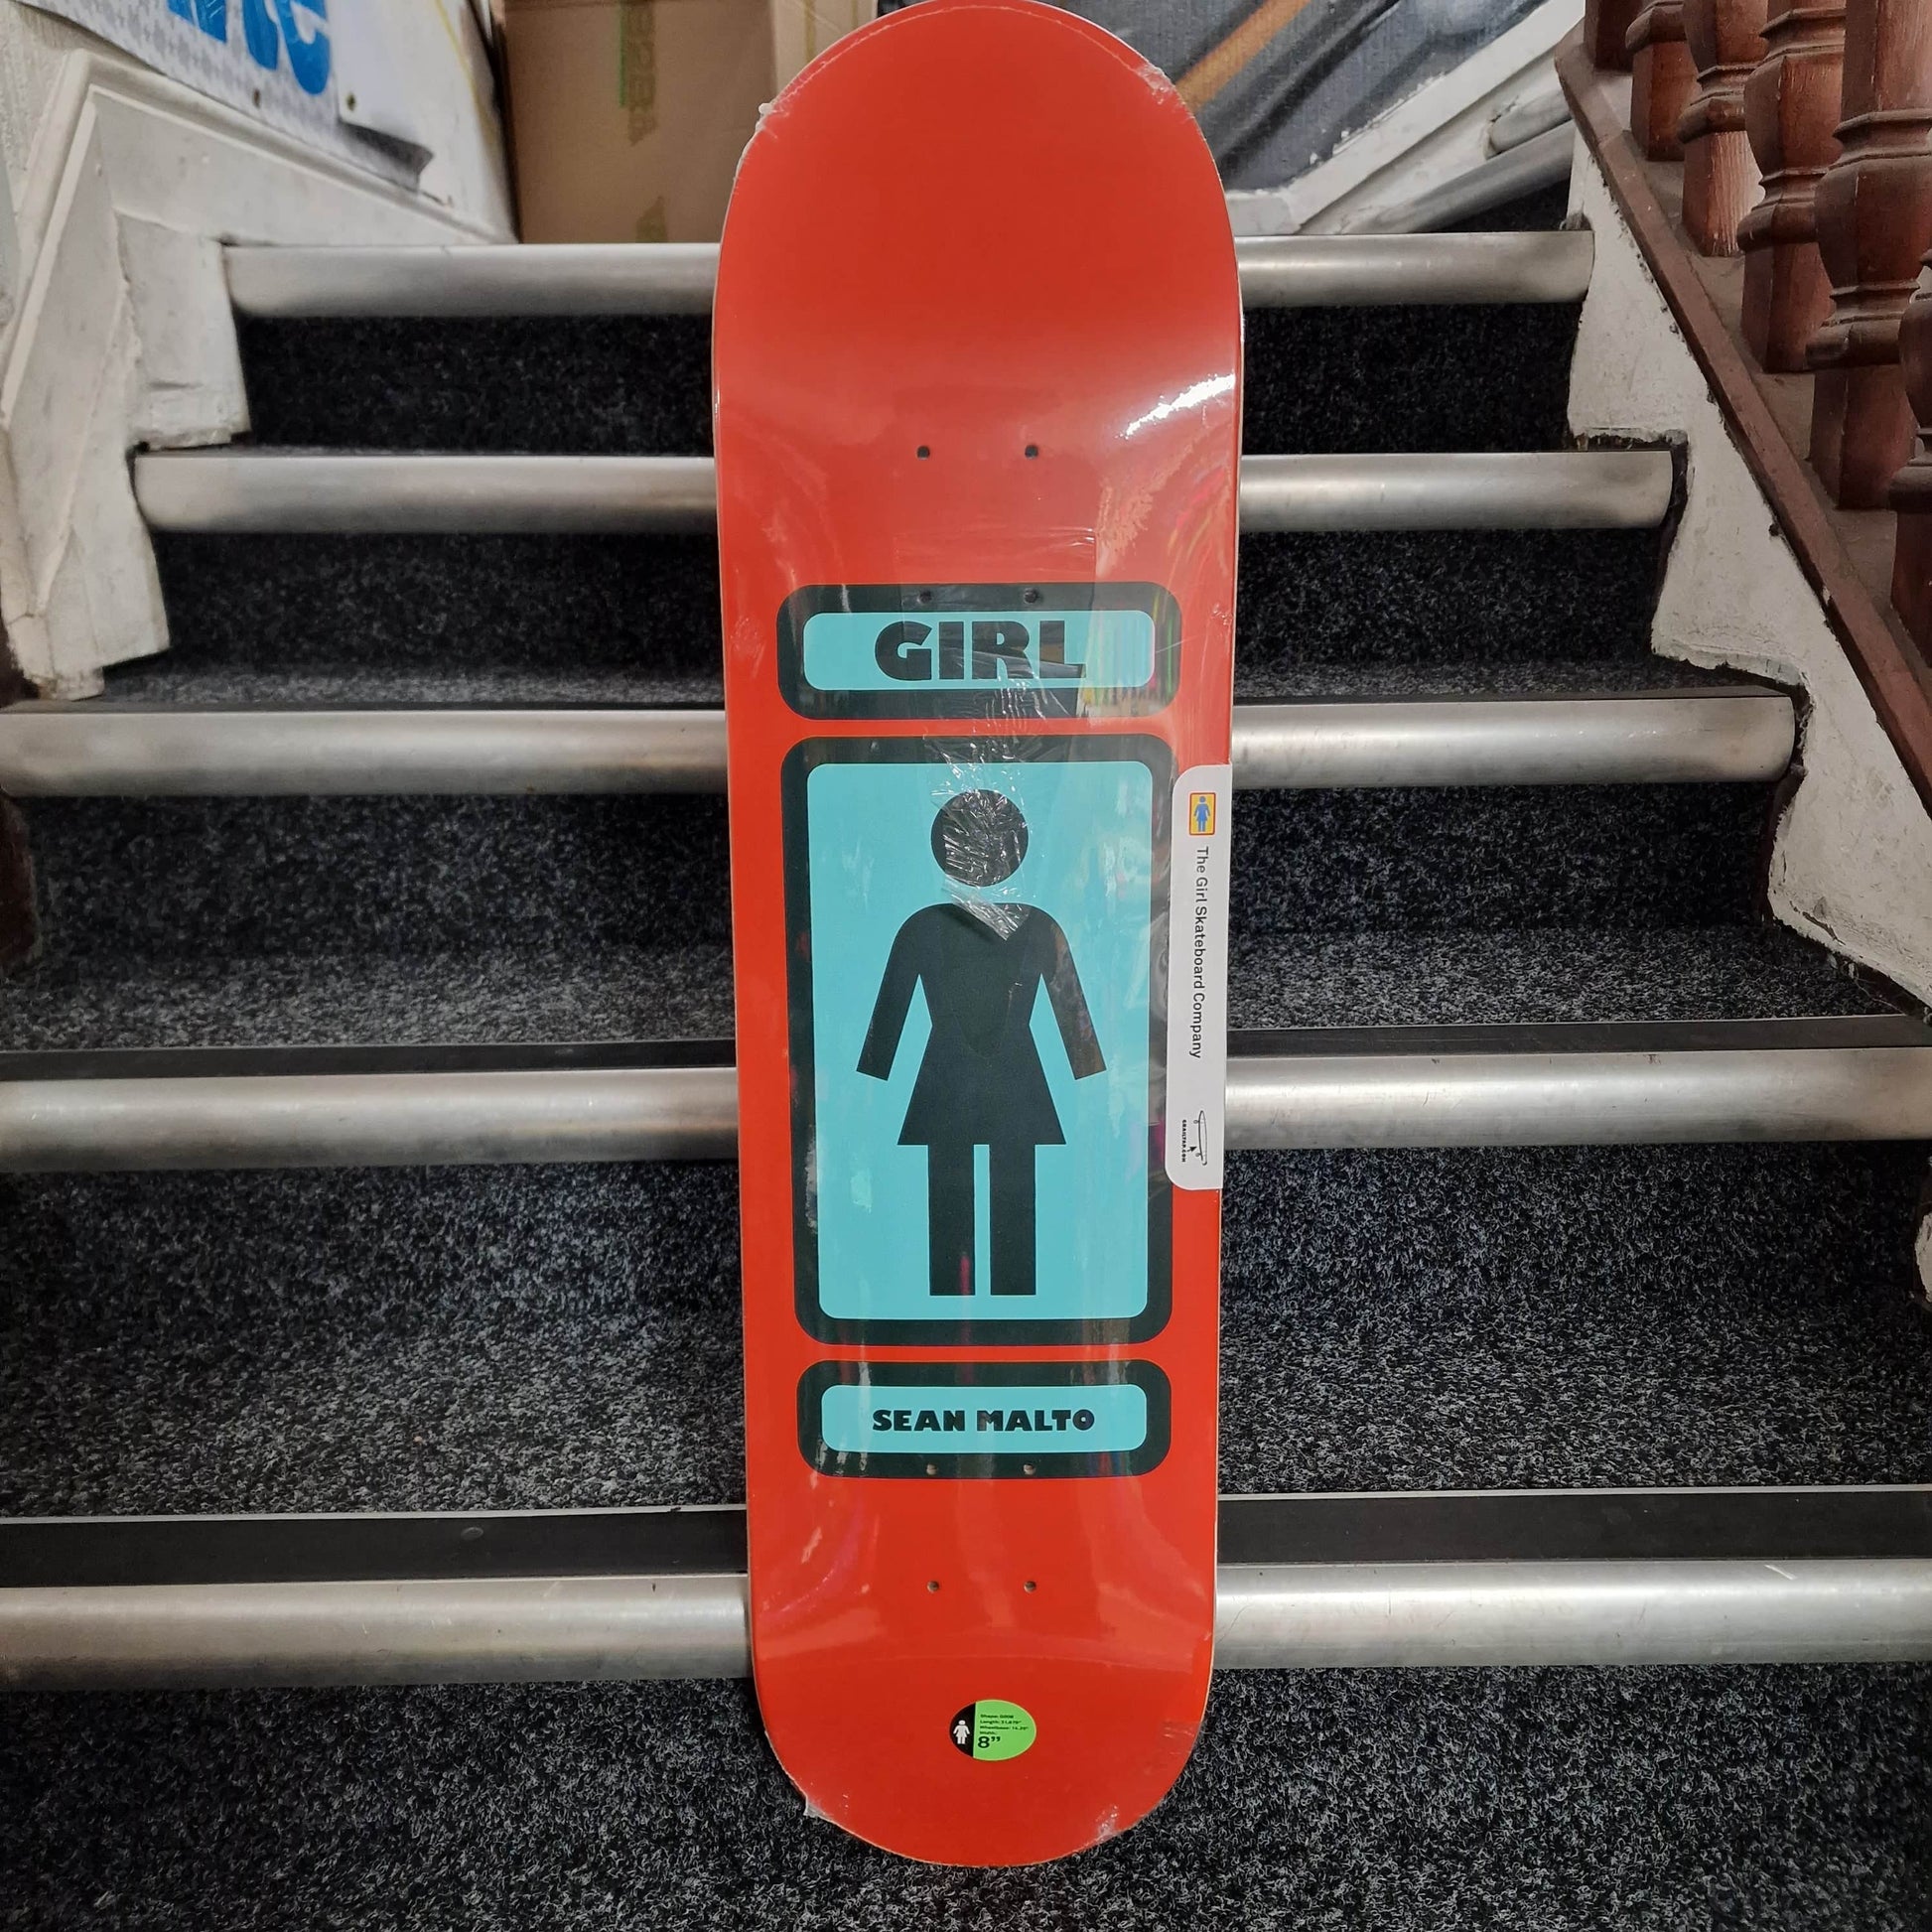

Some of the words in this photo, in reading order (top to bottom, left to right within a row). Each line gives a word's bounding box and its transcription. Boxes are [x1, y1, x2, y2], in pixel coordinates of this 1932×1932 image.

[875, 620, 1087, 681] GIRL
[1196, 846, 1209, 874] The
[1195, 876, 1208, 903] Girl
[1193, 905, 1207, 989] Skateboard
[1188, 992, 1205, 1059] Company
[872, 1409, 966, 1432] SEAN
[976, 1408, 1096, 1432] MALTO
